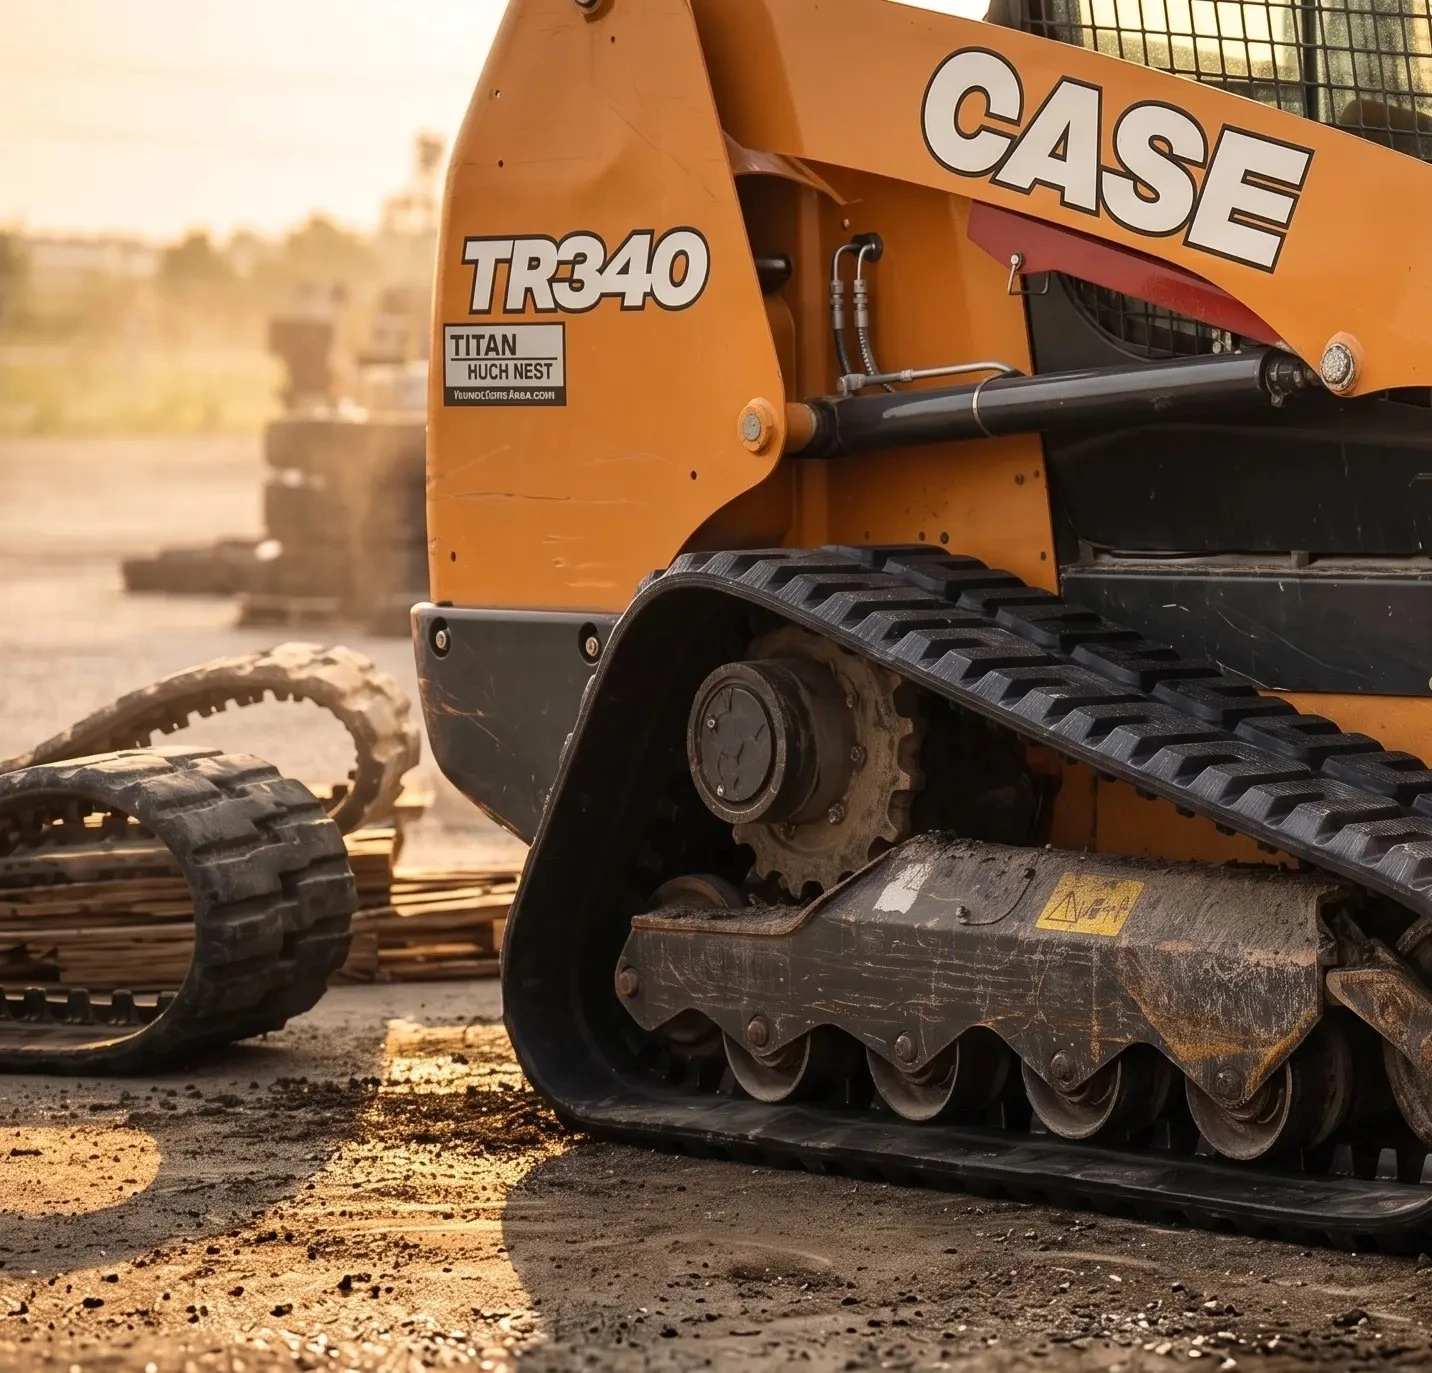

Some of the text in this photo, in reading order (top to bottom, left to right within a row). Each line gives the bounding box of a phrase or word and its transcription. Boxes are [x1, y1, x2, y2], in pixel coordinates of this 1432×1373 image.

[920, 46, 1316, 274] CASE
[461, 225, 711, 314] TR340
[450, 333, 517, 357] TITAN
[467, 362, 553, 380] HUCH NEST
